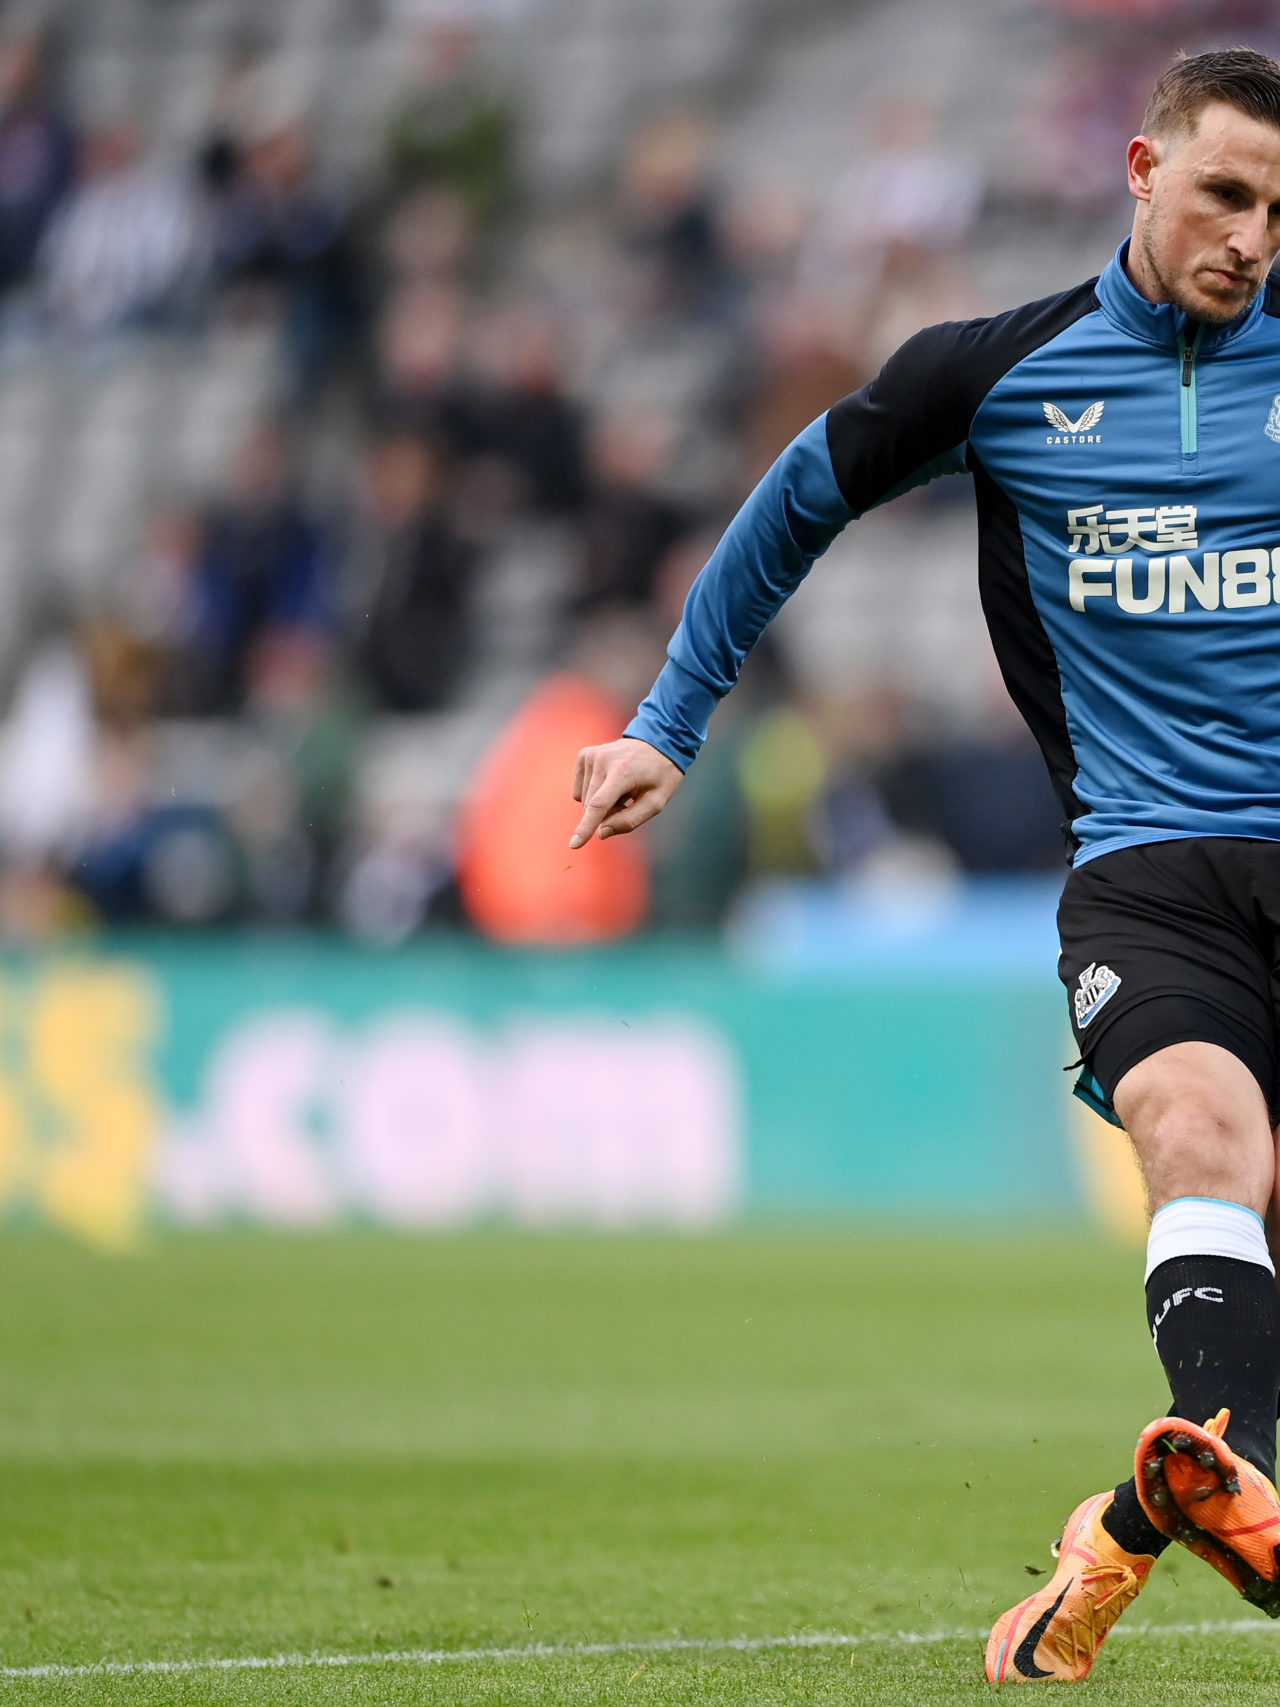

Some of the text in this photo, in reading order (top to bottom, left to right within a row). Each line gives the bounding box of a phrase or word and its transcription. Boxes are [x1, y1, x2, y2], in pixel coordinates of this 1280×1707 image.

[1046, 434, 1102, 445] CASTORE
[1067, 504, 1198, 555] 乐天堂
